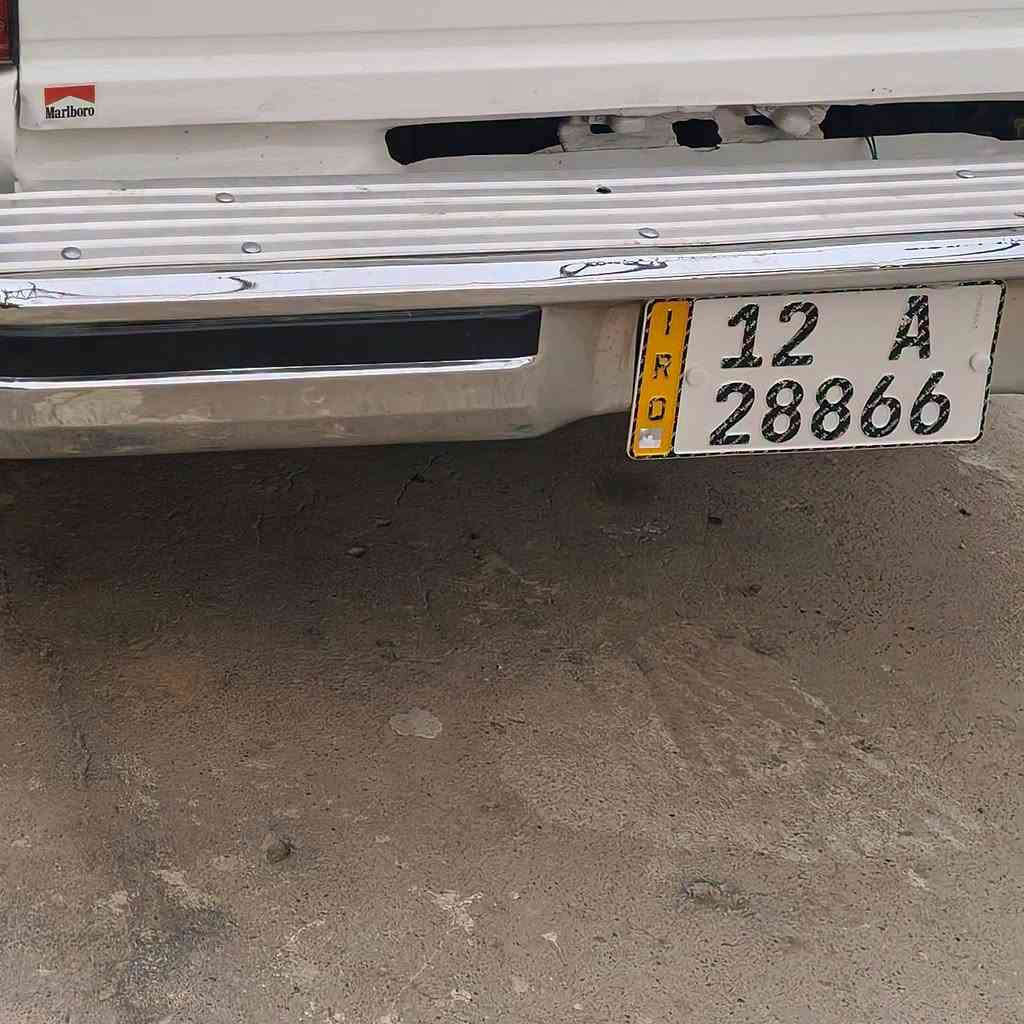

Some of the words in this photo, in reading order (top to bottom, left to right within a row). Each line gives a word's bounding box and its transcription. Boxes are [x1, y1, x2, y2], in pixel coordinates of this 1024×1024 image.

[45, 105, 95, 120] Marlboro
[720, 301, 819, 368] 12
[888, 295, 932, 361] A
[709, 371, 951, 446] 28866
